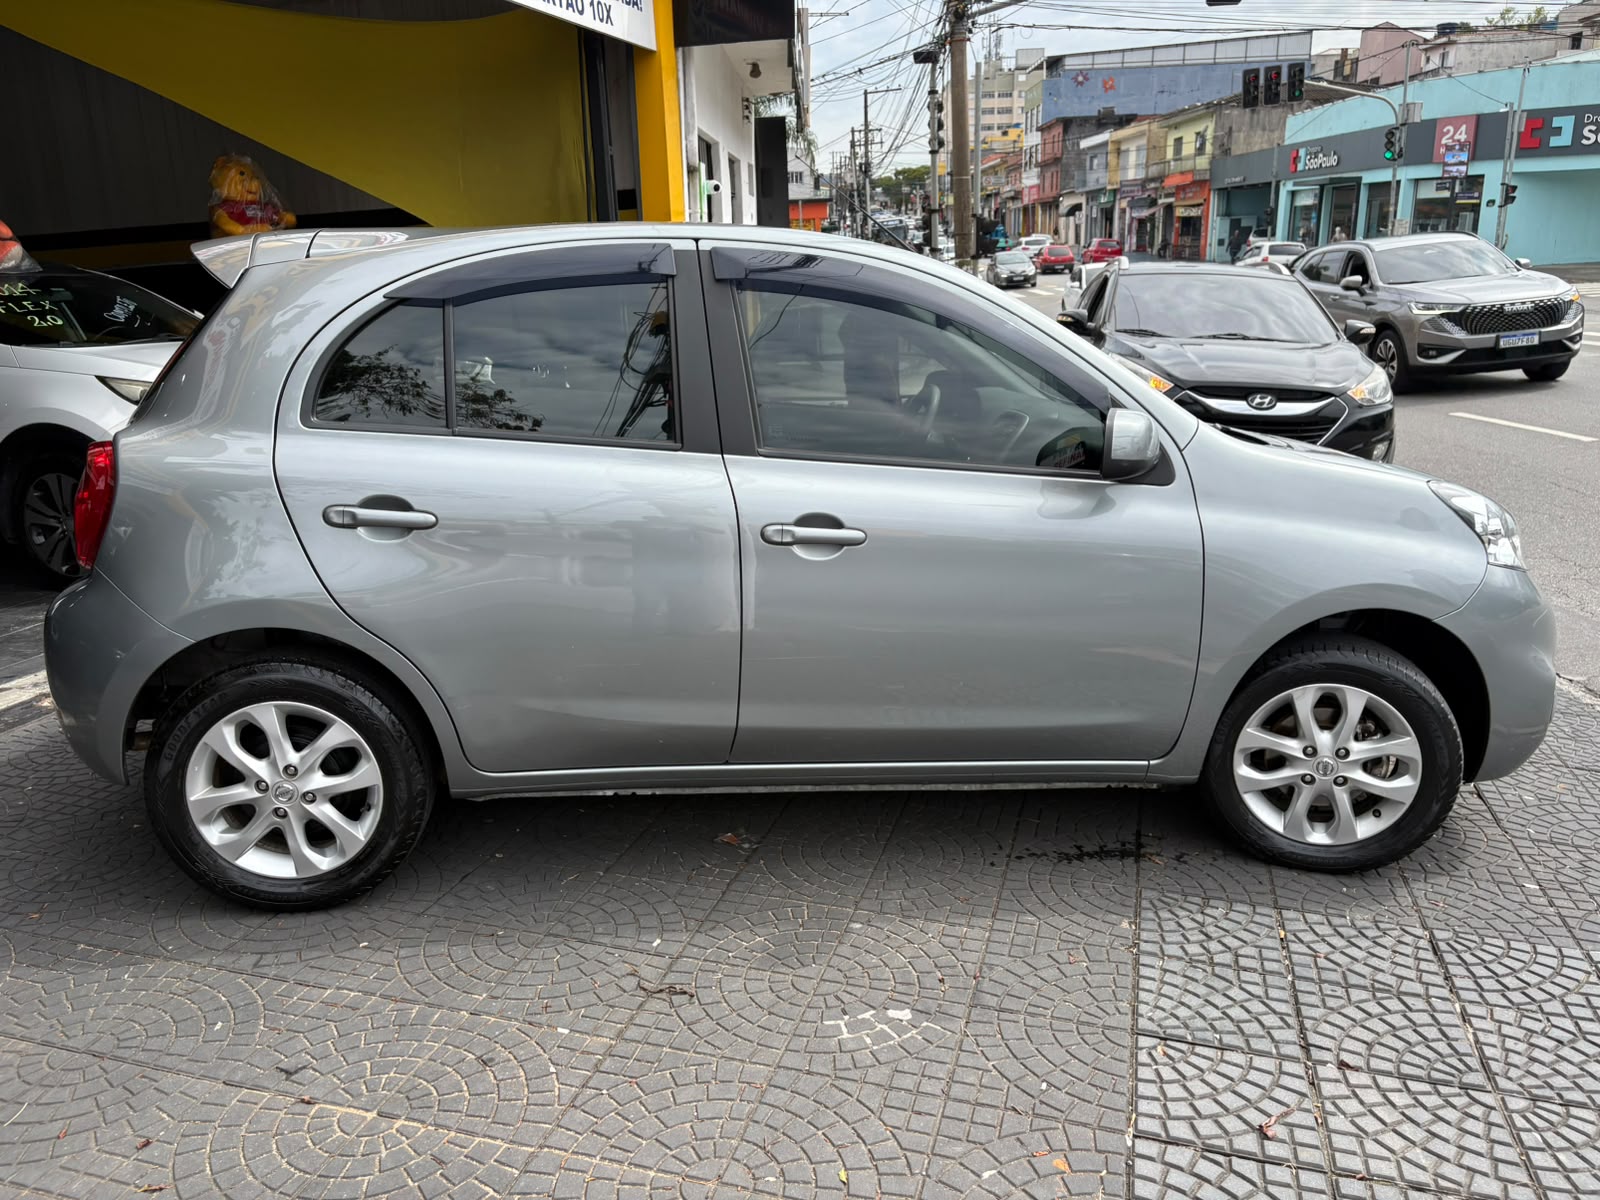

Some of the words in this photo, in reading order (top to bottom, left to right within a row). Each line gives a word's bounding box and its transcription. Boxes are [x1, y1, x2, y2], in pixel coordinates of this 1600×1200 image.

[589, 0, 614, 26] 10X
[1441, 124, 1467, 144] 24
[1580, 125, 1600, 145] S
